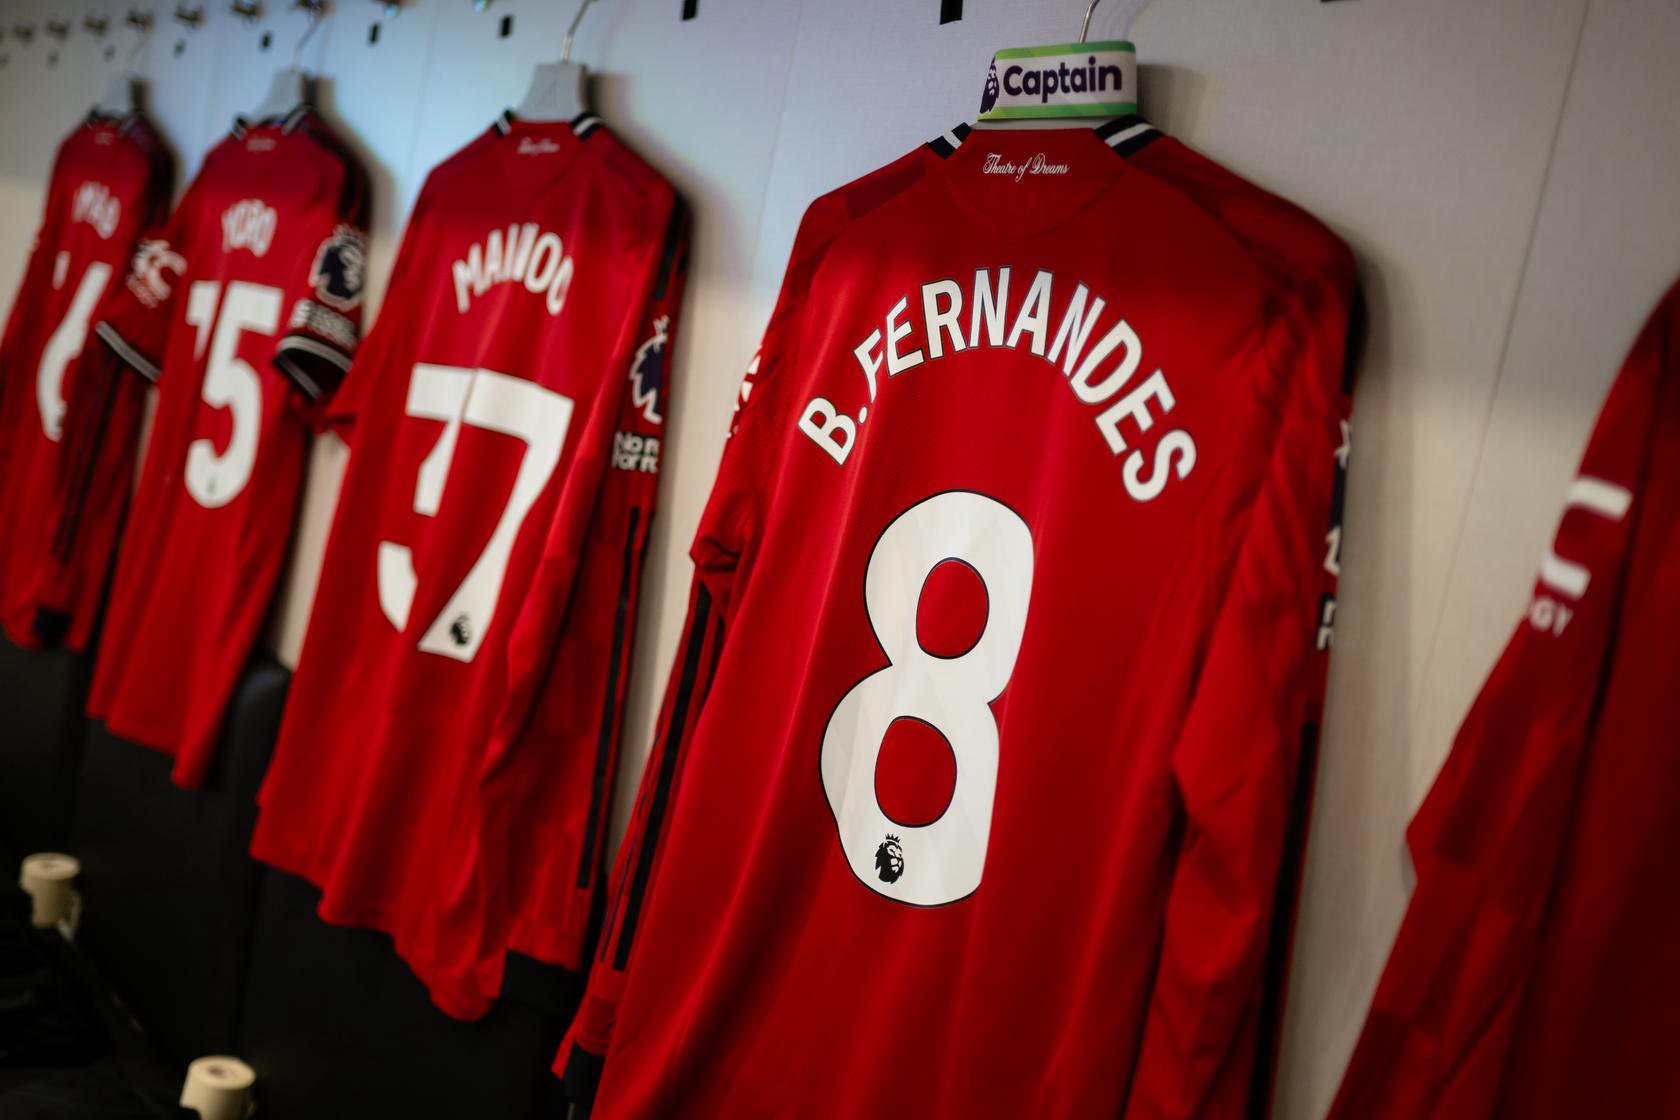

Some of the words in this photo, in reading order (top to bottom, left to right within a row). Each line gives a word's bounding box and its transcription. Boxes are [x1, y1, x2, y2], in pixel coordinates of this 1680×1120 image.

[1003, 56, 1122, 103] Captain
[983, 153, 1017, 174] Theatre
[1015, 157, 1033, 182] of
[1029, 153, 1069, 174] Dreams
[186, 280, 283, 508] 15
[818, 488, 1035, 908] 8
